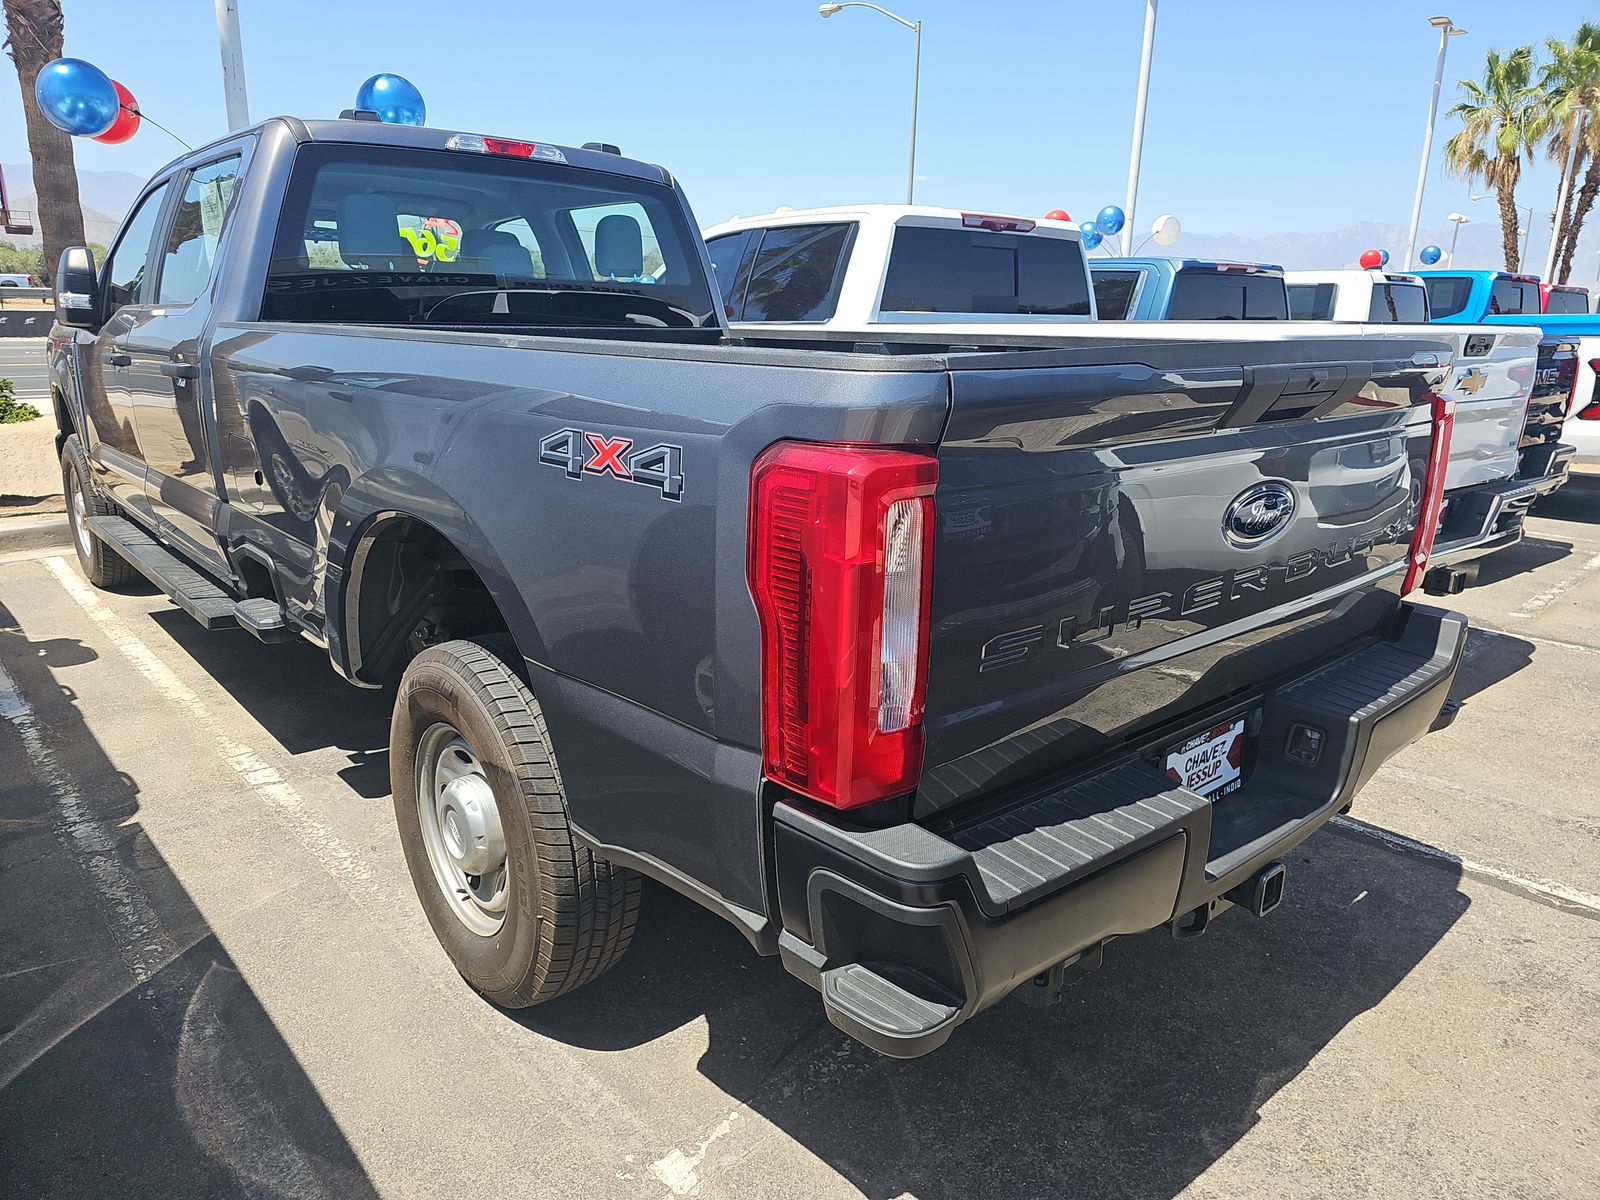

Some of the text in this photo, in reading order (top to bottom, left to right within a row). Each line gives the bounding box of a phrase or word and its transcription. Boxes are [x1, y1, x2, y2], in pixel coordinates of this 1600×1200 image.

[1245, 498, 1292, 533] Ford
[979, 518, 1407, 673] SUPER DUTY
[1185, 740, 1227, 773] CHAVEZ
